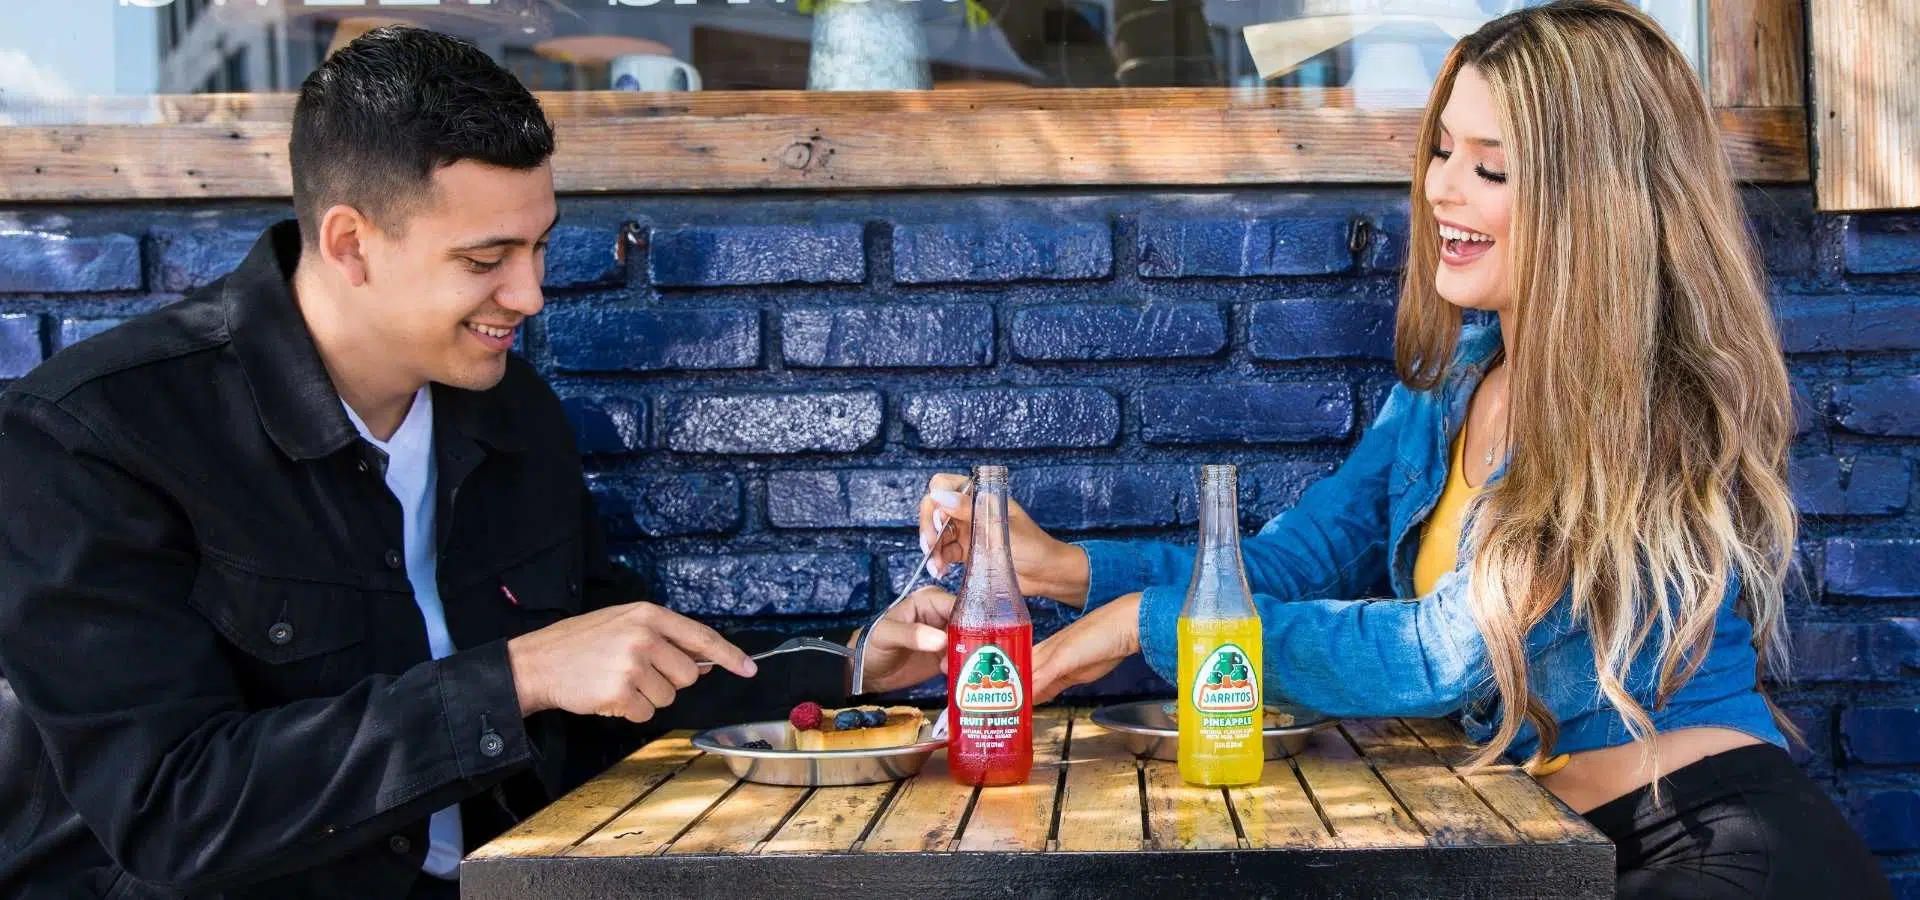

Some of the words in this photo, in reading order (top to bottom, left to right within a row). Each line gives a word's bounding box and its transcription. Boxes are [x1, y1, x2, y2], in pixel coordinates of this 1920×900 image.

[966, 692, 1013, 703] JARRITOS
[1204, 691, 1251, 703] JARRITOS
[960, 717, 984, 726] FRUIT
[987, 716, 1020, 726] PUNCH
[1203, 717, 1252, 726] PINEAPPLE
